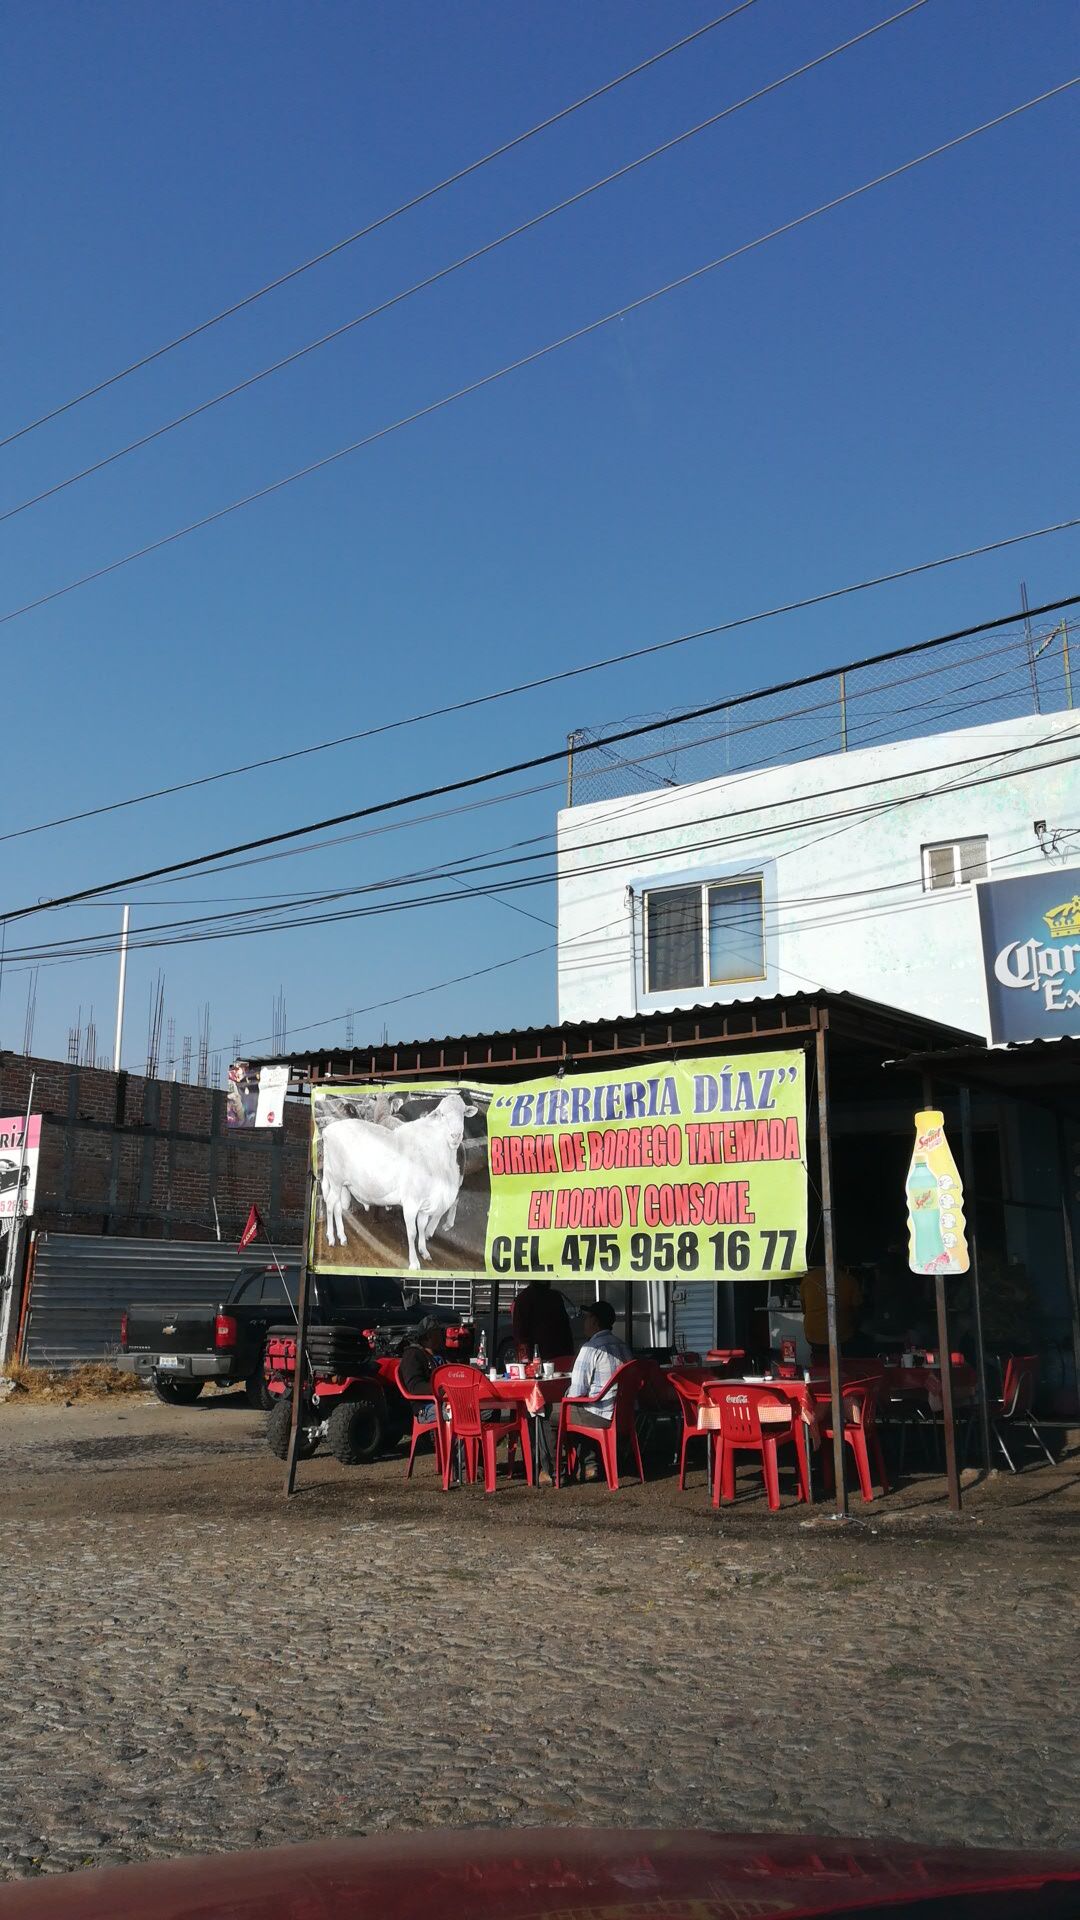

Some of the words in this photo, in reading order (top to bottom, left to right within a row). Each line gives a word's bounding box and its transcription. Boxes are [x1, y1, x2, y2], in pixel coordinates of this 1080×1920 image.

[496, 1077, 682, 1127] “BIRRIERIA
[491, 1133, 559, 1175] BIRRIA
[558, 1132, 586, 1172] DE
[588, 1124, 682, 1171] BORREGO
[685, 1116, 800, 1165] TATEMADA
[528, 1190, 554, 1229] EN
[554, 1185, 623, 1229] HORNO
[625, 1185, 641, 1227] Y
[644, 1180, 755, 1227] CONSOME.
[491, 1235, 554, 1273] CEL.
[561, 1234, 621, 1272] 475
[630, 1231, 699, 1272] 958
[708, 1230, 750, 1271] 16
[760, 1230, 797, 1270] 77
